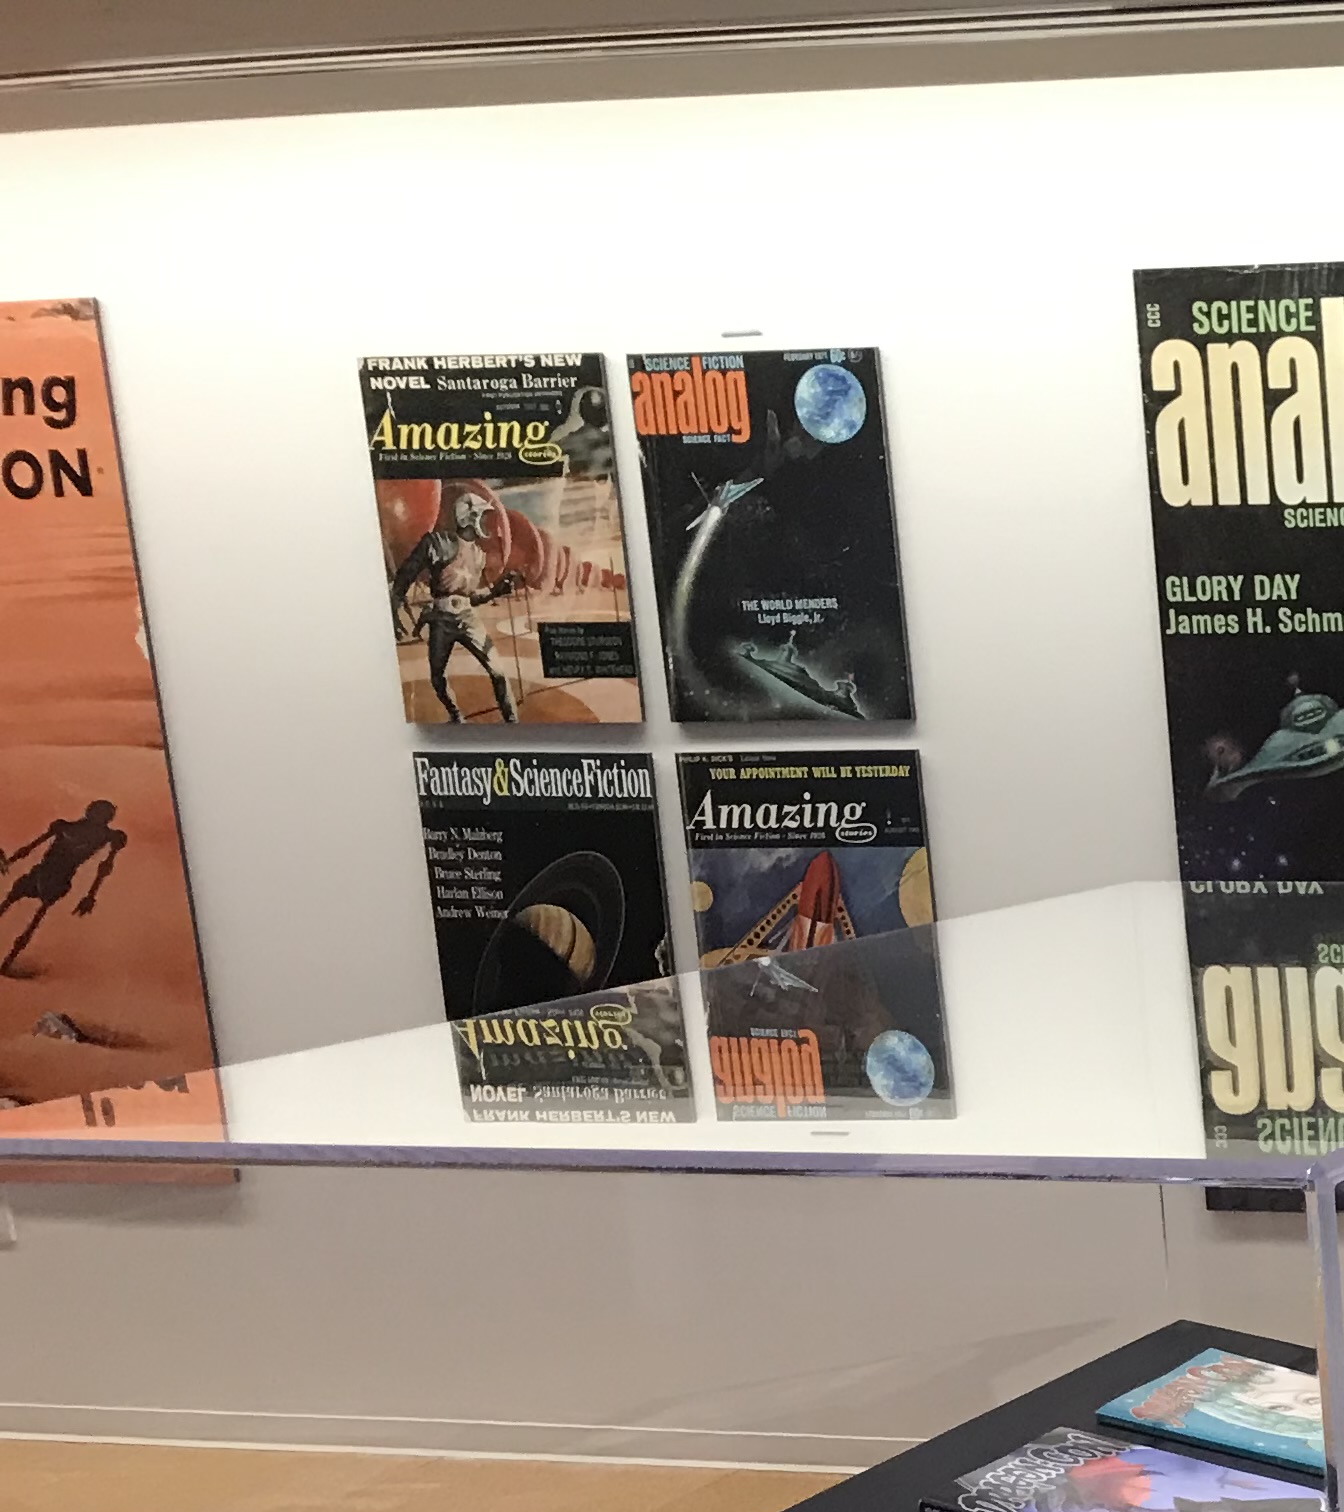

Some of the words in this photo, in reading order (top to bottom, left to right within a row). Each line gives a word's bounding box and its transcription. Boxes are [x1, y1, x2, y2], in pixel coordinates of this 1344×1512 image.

[1191, 297, 1317, 335] SCIENCE
[367, 356, 429, 371] FRANK
[432, 354, 536, 370] HERBERT'S
[540, 352, 583, 367] NEW
[645, 357, 690, 372] SCIENCE
[702, 355, 744, 369] FICTION
[369, 376, 431, 390] NOVEL
[436, 374, 519, 392] Santaroga
[521, 372, 578, 389] Barrier
[631, 355, 750, 444] analog
[368, 408, 552, 456] Amazing
[1165, 574, 1245, 603] GLORY
[1253, 573, 1301, 601] DAY
[742, 600, 760, 611] THE
[761, 599, 794, 611] WORLD
[1165, 608, 1240, 635] James
[1246, 608, 1272, 634] H.
[709, 767, 737, 780] YOUR
[739, 767, 809, 779] APPOINTMENT
[811, 766, 839, 779] WILL
[854, 765, 911, 778] YESTERDAY
[685, 788, 868, 834] Amazing
